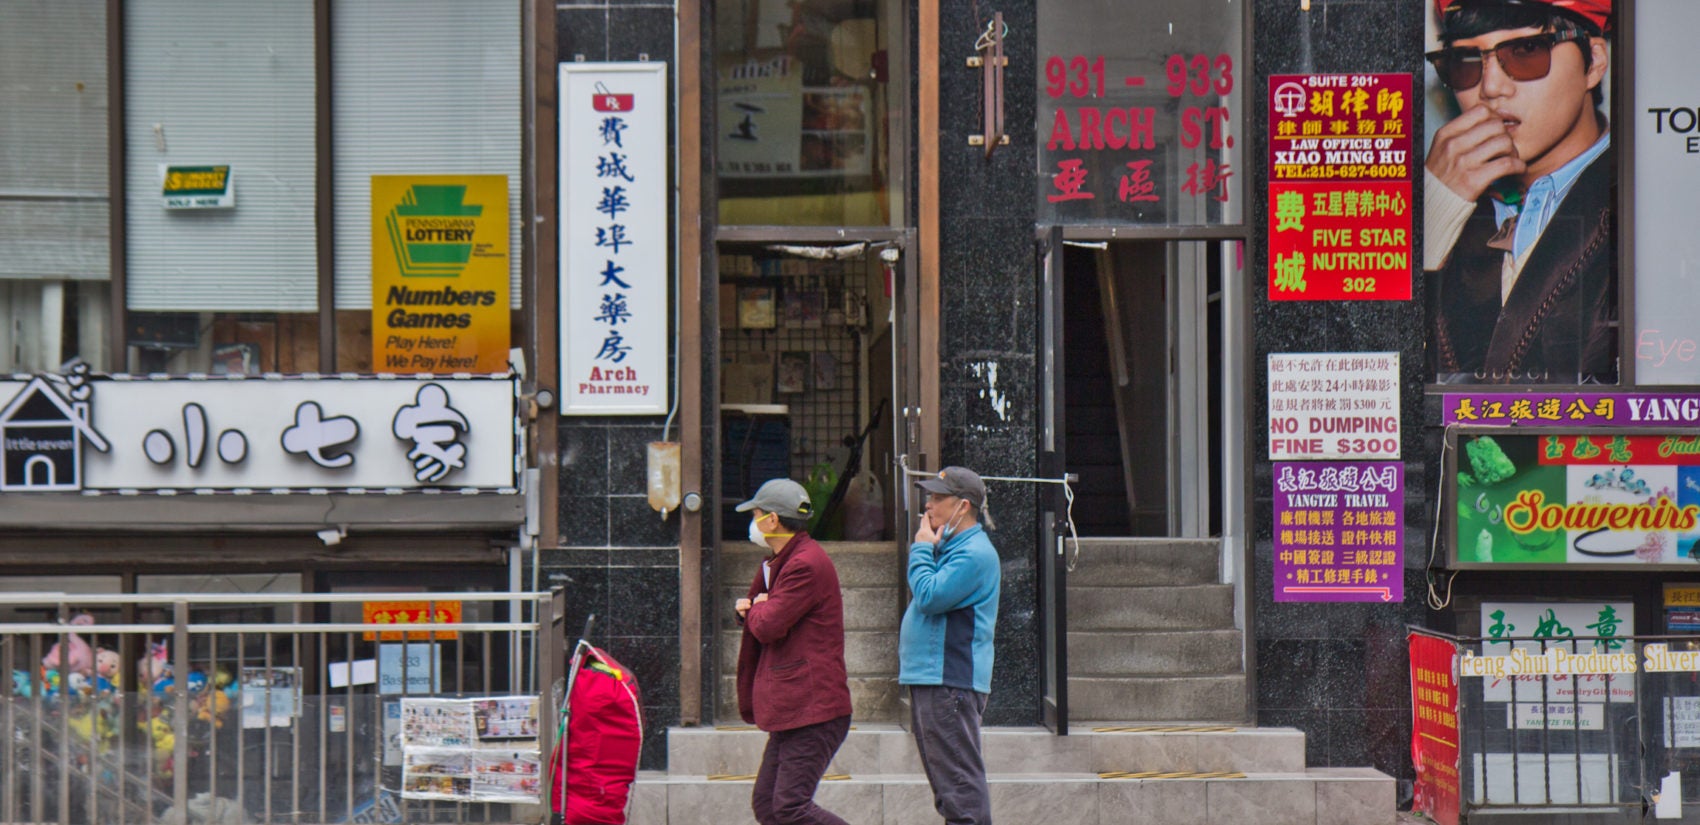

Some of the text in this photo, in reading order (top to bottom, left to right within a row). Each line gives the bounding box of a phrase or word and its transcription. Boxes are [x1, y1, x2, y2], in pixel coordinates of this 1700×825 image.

[1045, 55, 1105, 98] 931
[1166, 53, 1234, 97] 933
[1308, 76, 1373, 87] SUITE 201
[1309, 87, 1404, 119] 胡律師
[1046, 107, 1234, 151] ARCH ST.
[1277, 119, 1403, 135] 律師事務所
[1290, 138, 1393, 150] LAW OFFICE OF
[1686, 136, 1700, 153] E
[1274, 151, 1406, 164] XIAO MING HU
[1274, 165, 1407, 178] TEL:215-627-6002
[1312, 190, 1406, 218] 五星营养中心
[405, 219, 475, 229] PENNSYLVANIA
[406, 229, 475, 242] LOTTERY
[593, 116, 635, 364] 費城華埠大藥房
[1274, 190, 1307, 293] 费城
[1313, 228, 1406, 247] FIVE STAR
[1312, 252, 1406, 271] NUTRITION
[1343, 277, 1376, 293] 302
[386, 285, 496, 306] Numbers
[386, 308, 471, 329] Games
[386, 336, 456, 351] Play Here!
[1636, 328, 1697, 368] Eye
[386, 355, 478, 370] We Pay Here!
[589, 366, 637, 382] Arch
[578, 383, 649, 396] Pharmacy
[1454, 398, 1615, 420] 長江旅遊公司
[1627, 398, 1700, 420] YANG
[142, 382, 471, 483] 小七家
[1271, 417, 1398, 434] NO DUMPING
[1272, 438, 1398, 455] FINE $300
[1545, 435, 1633, 462] 玉如意
[1658, 435, 1700, 458] Jad
[1277, 466, 1398, 492] 長江旅遊公司
[1287, 494, 1389, 508] YANGTZE TRAVEL
[1342, 511, 1396, 526] 各地旅遊
[1505, 490, 1697, 533] Souvenirs
[1280, 530, 1396, 546] 機場接送 證件快相
[1341, 550, 1396, 565] 三級認證
[1296, 568, 1378, 585] 精工修理手錶
[1488, 604, 1627, 650] 玉如意
[1461, 649, 1505, 678] Feng
[1510, 647, 1549, 674] Shui
[1555, 646, 1637, 673] Products
[1643, 645, 1698, 671] Silver
[382, 674, 432, 686] Basmen
[1556, 688, 1592, 697] Jewlry
[1612, 688, 1634, 697] Shop
